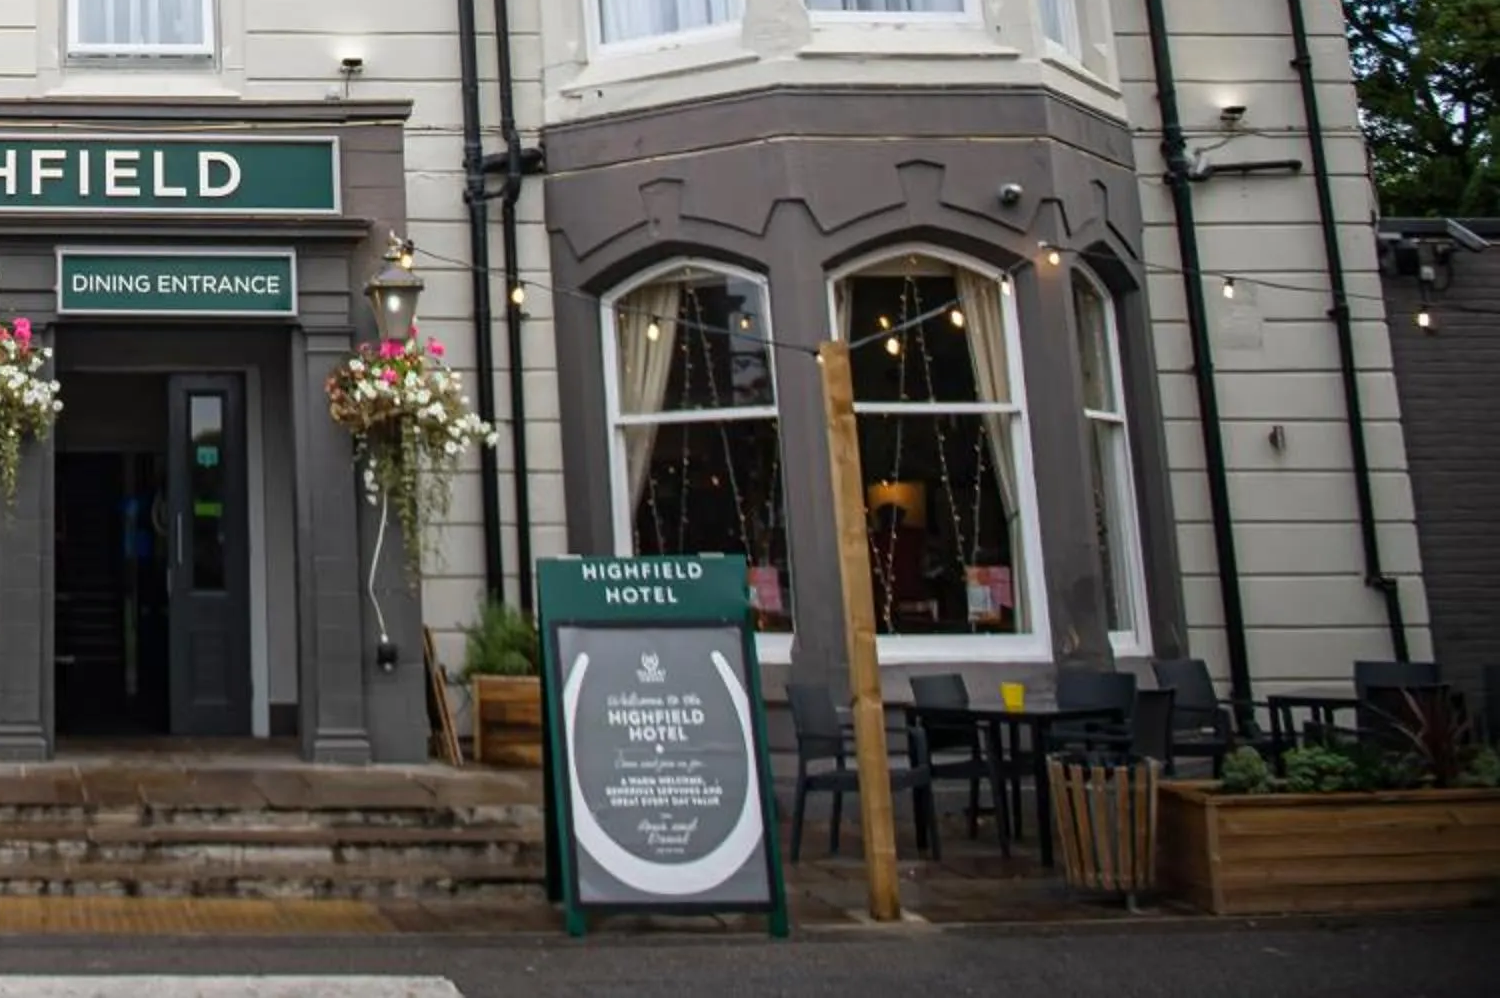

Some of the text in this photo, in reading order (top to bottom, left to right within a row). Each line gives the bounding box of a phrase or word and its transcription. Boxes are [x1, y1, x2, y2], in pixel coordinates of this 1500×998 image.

[72, 273, 280, 295] DINING ENTRANCE
[581, 561, 703, 581] HIGHFIELD
[605, 585, 678, 604] HOTEL
[607, 708, 705, 726] HIGHFIELD
[628, 725, 689, 742] HOTEL
